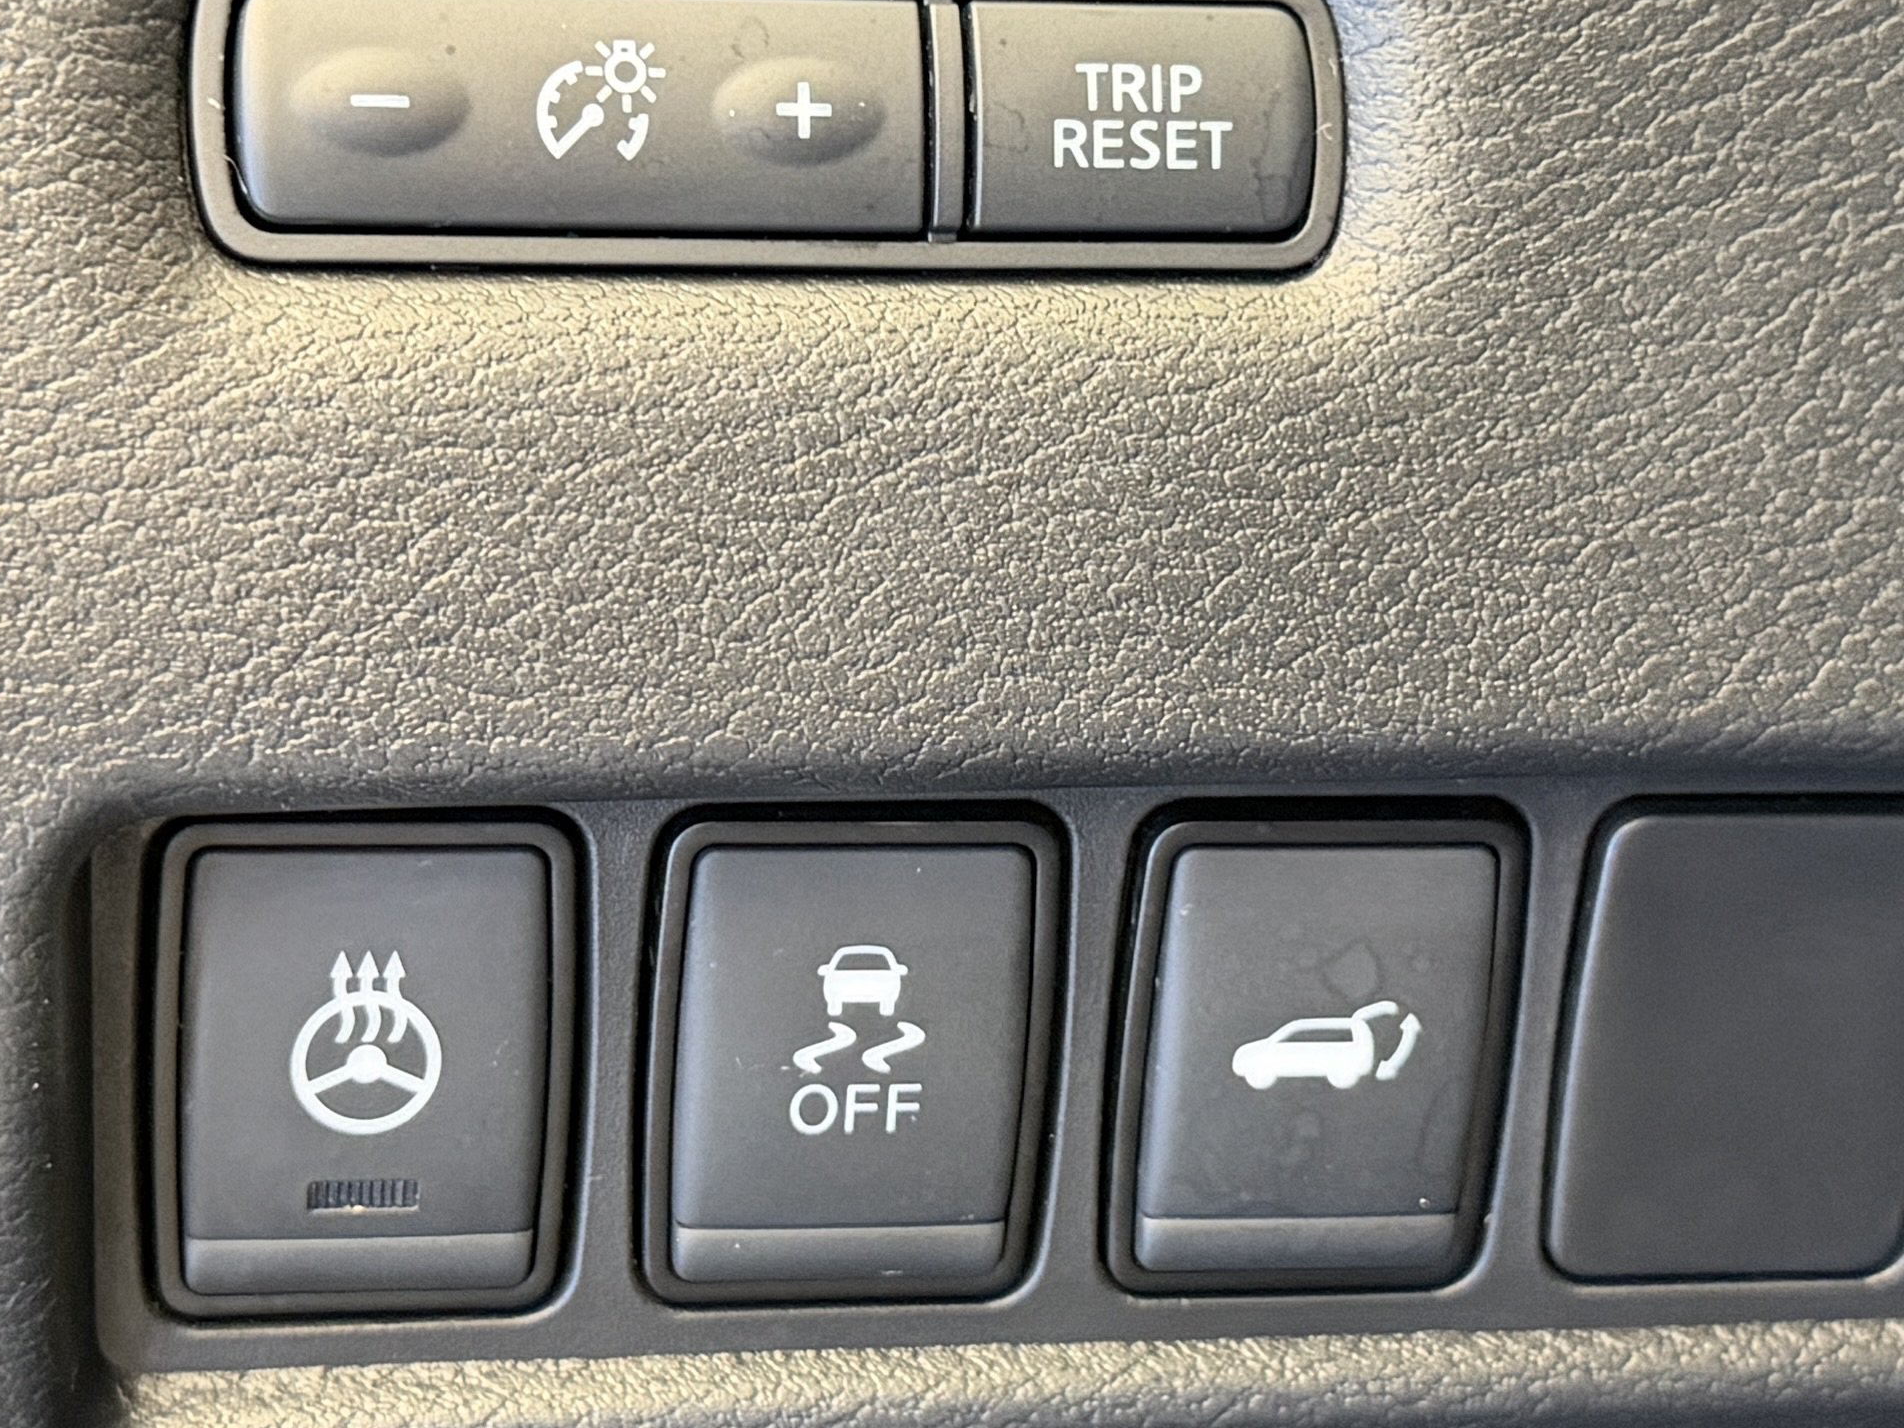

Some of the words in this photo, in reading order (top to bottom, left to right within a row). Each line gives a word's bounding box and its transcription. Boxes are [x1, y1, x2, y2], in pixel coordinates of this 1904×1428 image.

[1073, 61, 1204, 114] TRIP
[1052, 117, 1235, 171] RESET
[788, 1082, 924, 1136] OFF
